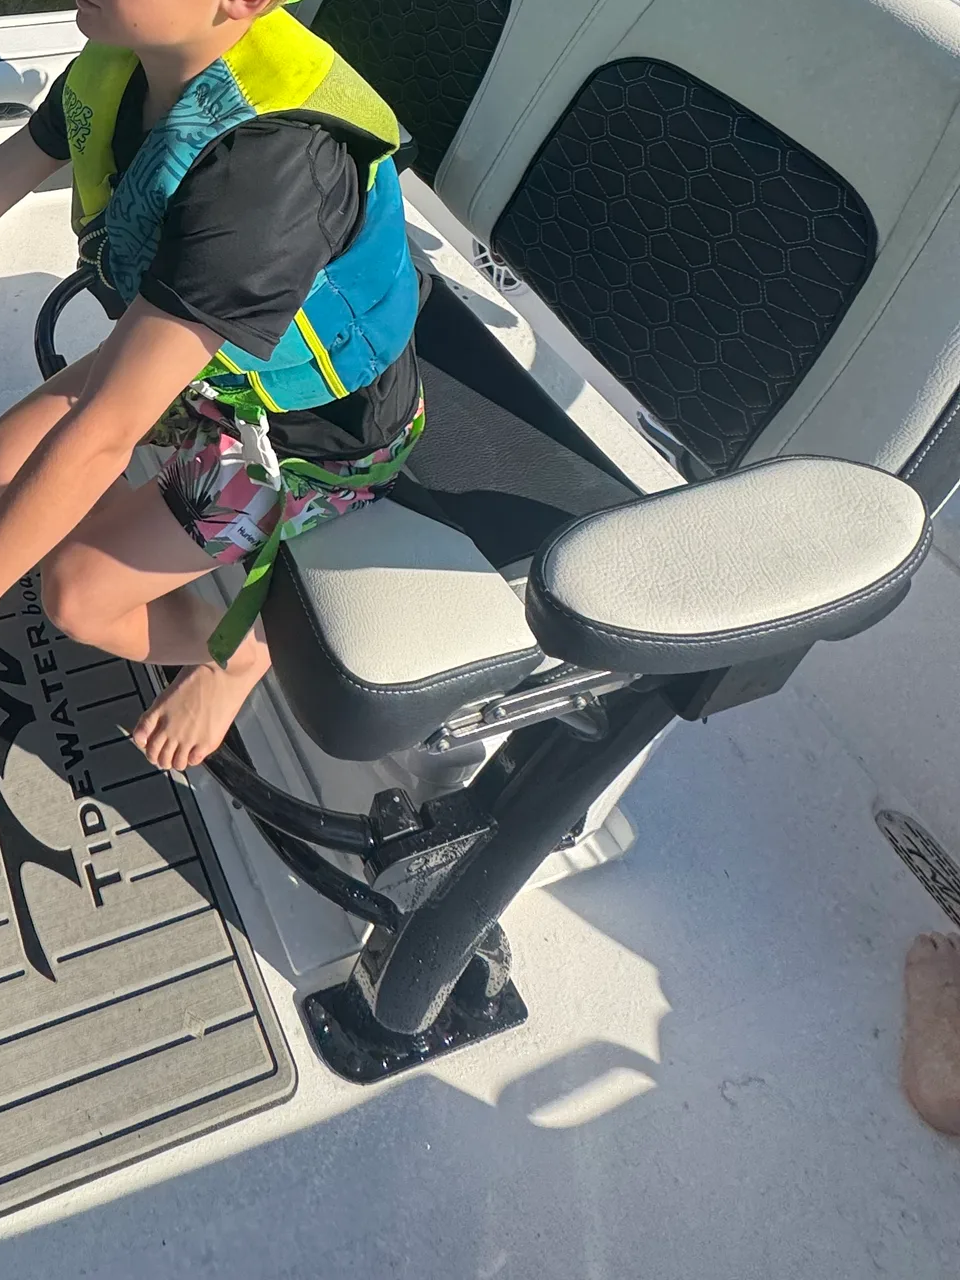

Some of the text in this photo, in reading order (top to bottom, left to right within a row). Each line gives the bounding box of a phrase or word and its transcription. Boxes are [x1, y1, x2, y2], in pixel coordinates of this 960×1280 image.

[237, 526, 257, 545] Hurley
[20, 572, 122, 908] TIDEWATER boa
